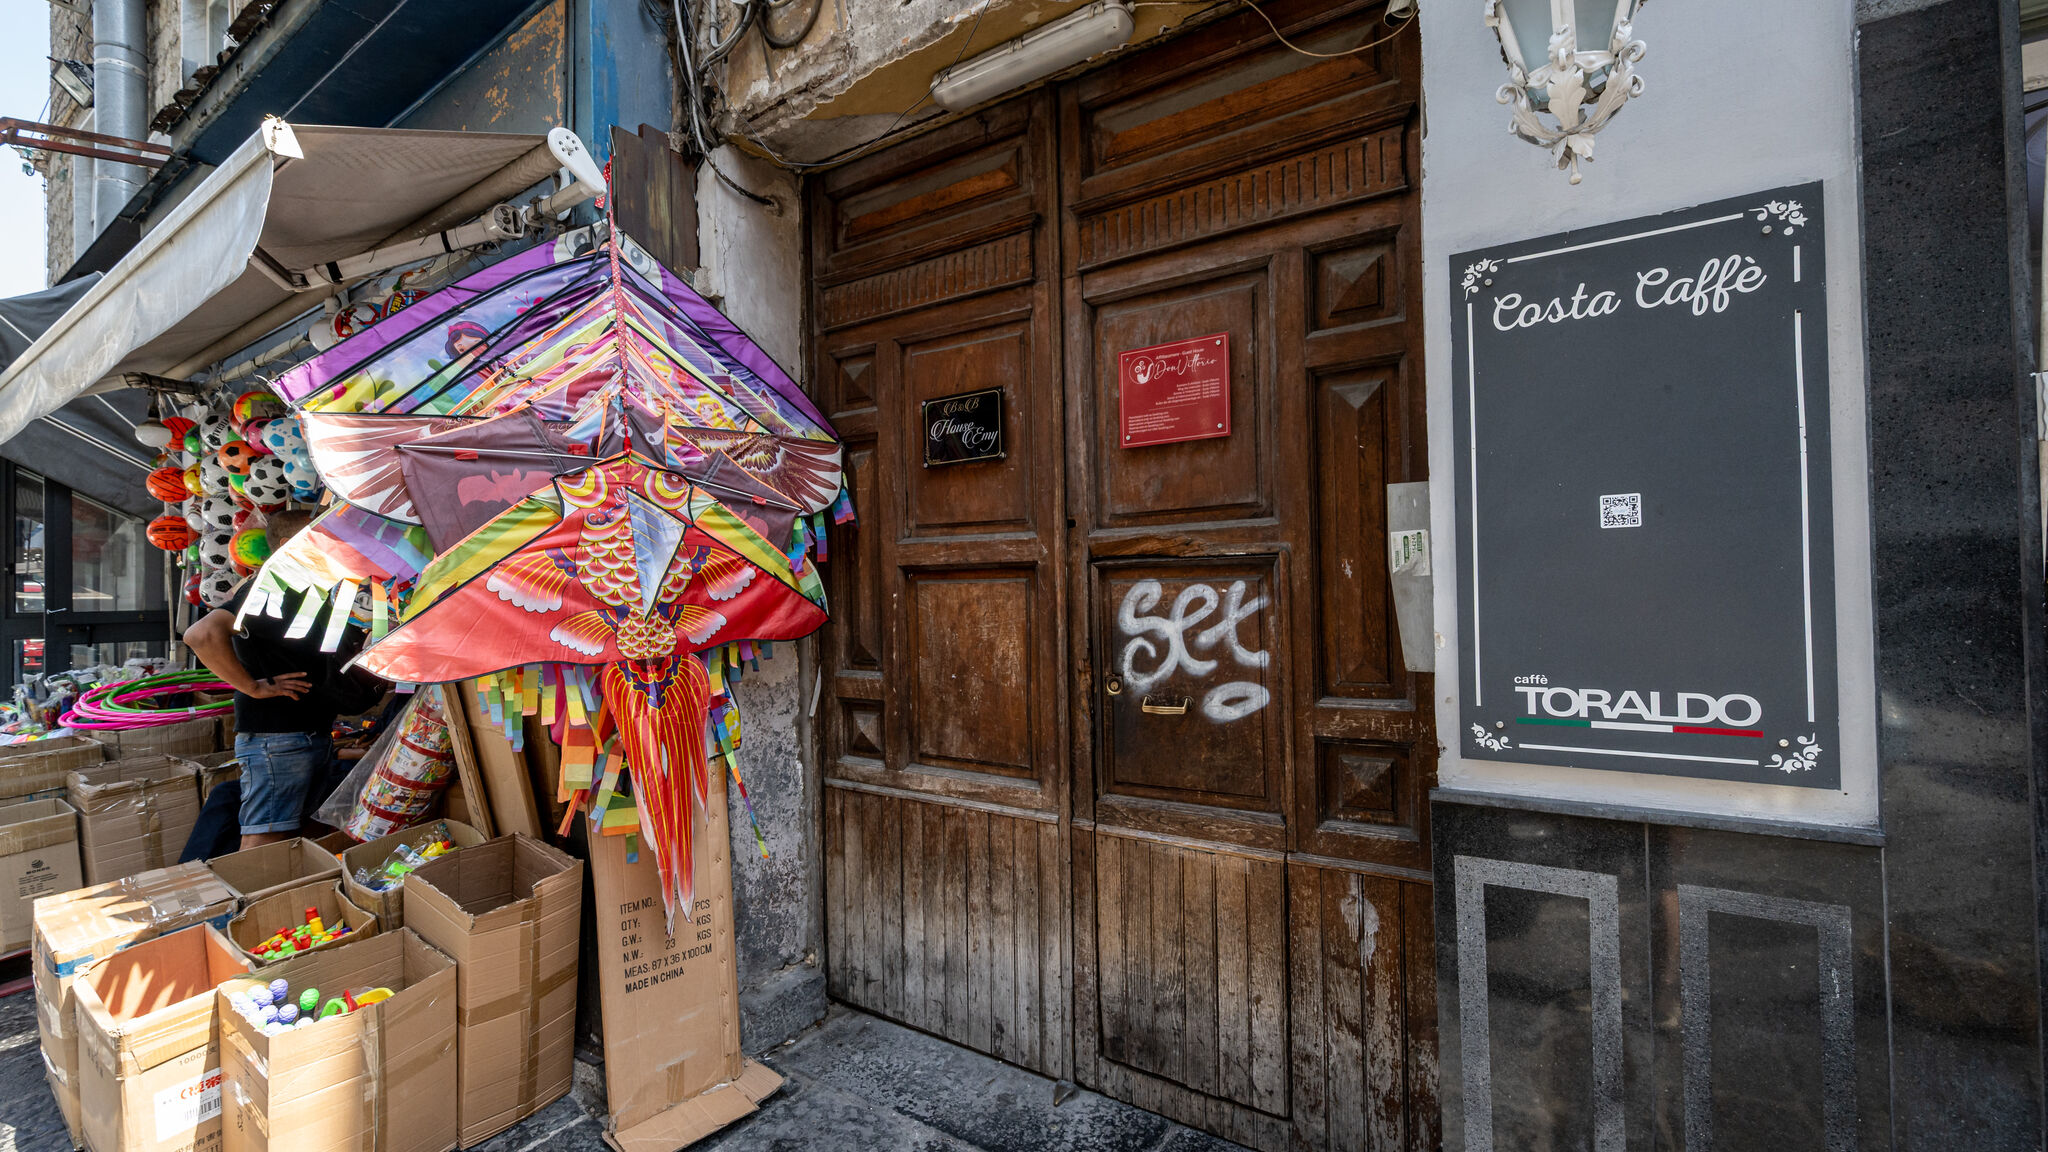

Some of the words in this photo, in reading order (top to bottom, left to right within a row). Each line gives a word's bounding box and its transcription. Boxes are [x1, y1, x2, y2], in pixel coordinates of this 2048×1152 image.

[1493, 283, 1622, 331] Costa
[1636, 254, 1767, 316] Caffè
[930, 418, 976, 442] House
[962, 426, 999, 452] Emy
[1514, 675, 1548, 685] caffè
[1515, 686, 1762, 727] TORALDO
[620, 901, 640, 915] ITEM
[621, 918, 641, 932] QTY:
[695, 899, 711, 912] PCS
[696, 914, 711, 926] KGS
[665, 938, 676, 950] 23
[697, 929, 712, 941] KGS
[624, 963, 651, 979] MEAS:
[651, 959, 662, 971] 87
[670, 953, 680, 965] 36
[625, 978, 649, 994] MADE
[650, 975, 659, 986] IN
[660, 966, 685, 983] CHINA
